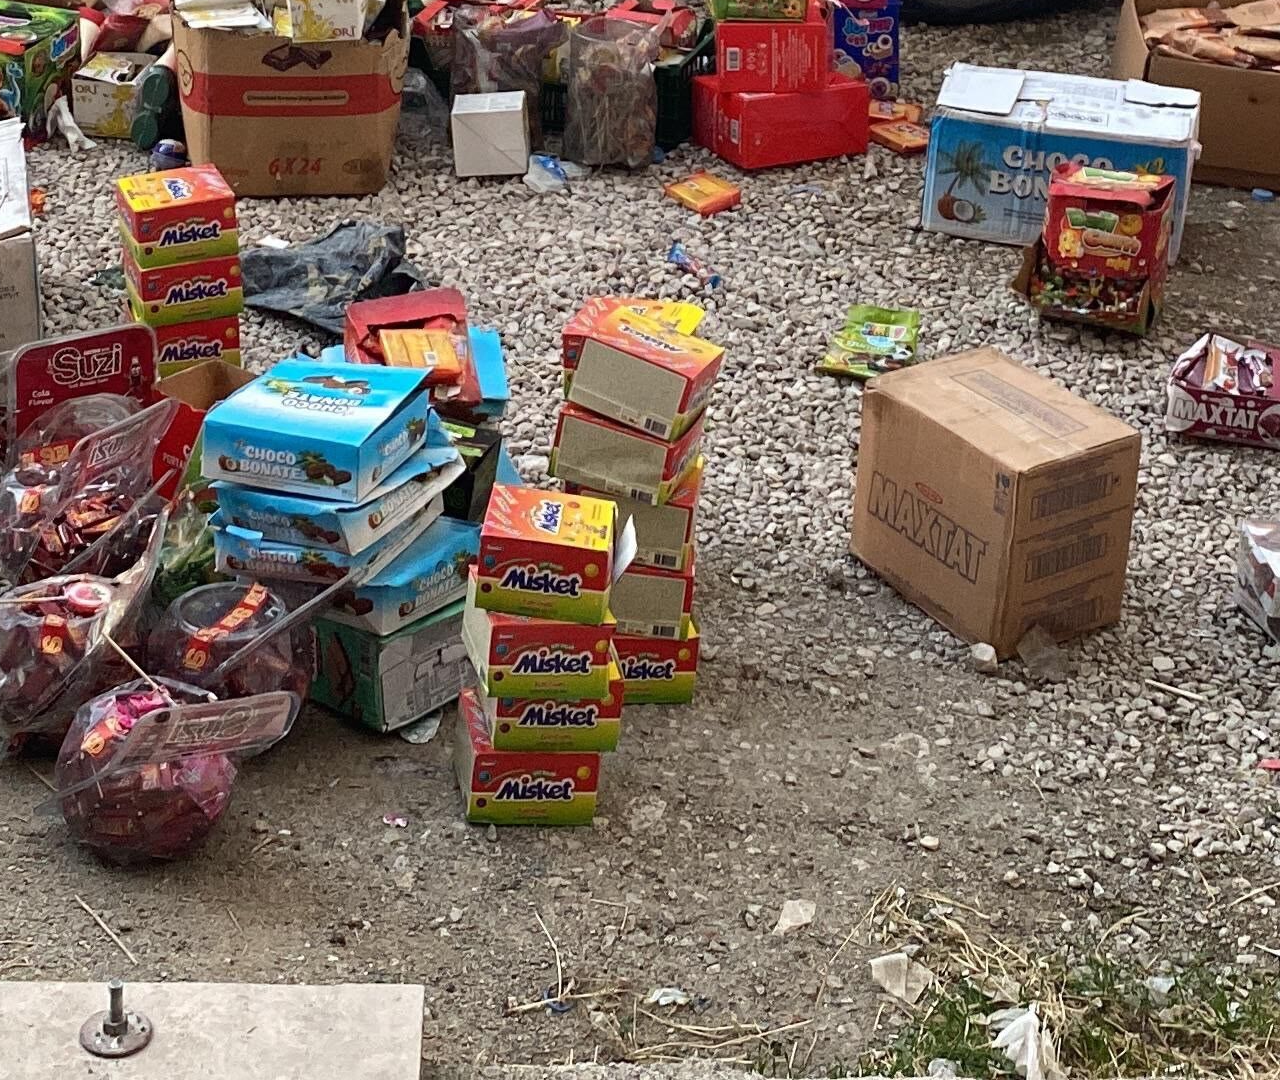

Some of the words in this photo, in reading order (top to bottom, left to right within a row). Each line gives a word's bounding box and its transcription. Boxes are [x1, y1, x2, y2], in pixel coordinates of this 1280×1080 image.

[1002, 145, 1114, 171] CHOCO
[988, 170, 1049, 202] BON
[159, 223, 220, 247] Misket
[166, 280, 227, 305] Misket
[160, 341, 222, 362] Misket
[53, 344, 122, 386] Suzi
[29, 397, 54, 407] Flavor
[32, 389, 50, 399] Cola
[286, 391, 362, 406] BONATE
[280, 398, 347, 416] CHOCO
[1172, 396, 1260, 429] MAXTAT
[246, 446, 296, 466] CHOCO
[239, 459, 305, 480] BONATE
[868, 471, 988, 584] MAXTAT
[501, 565, 581, 596] Misket
[512, 650, 590, 674] Misket
[520, 702, 598, 727] Misket
[495, 777, 574, 801] Misket
